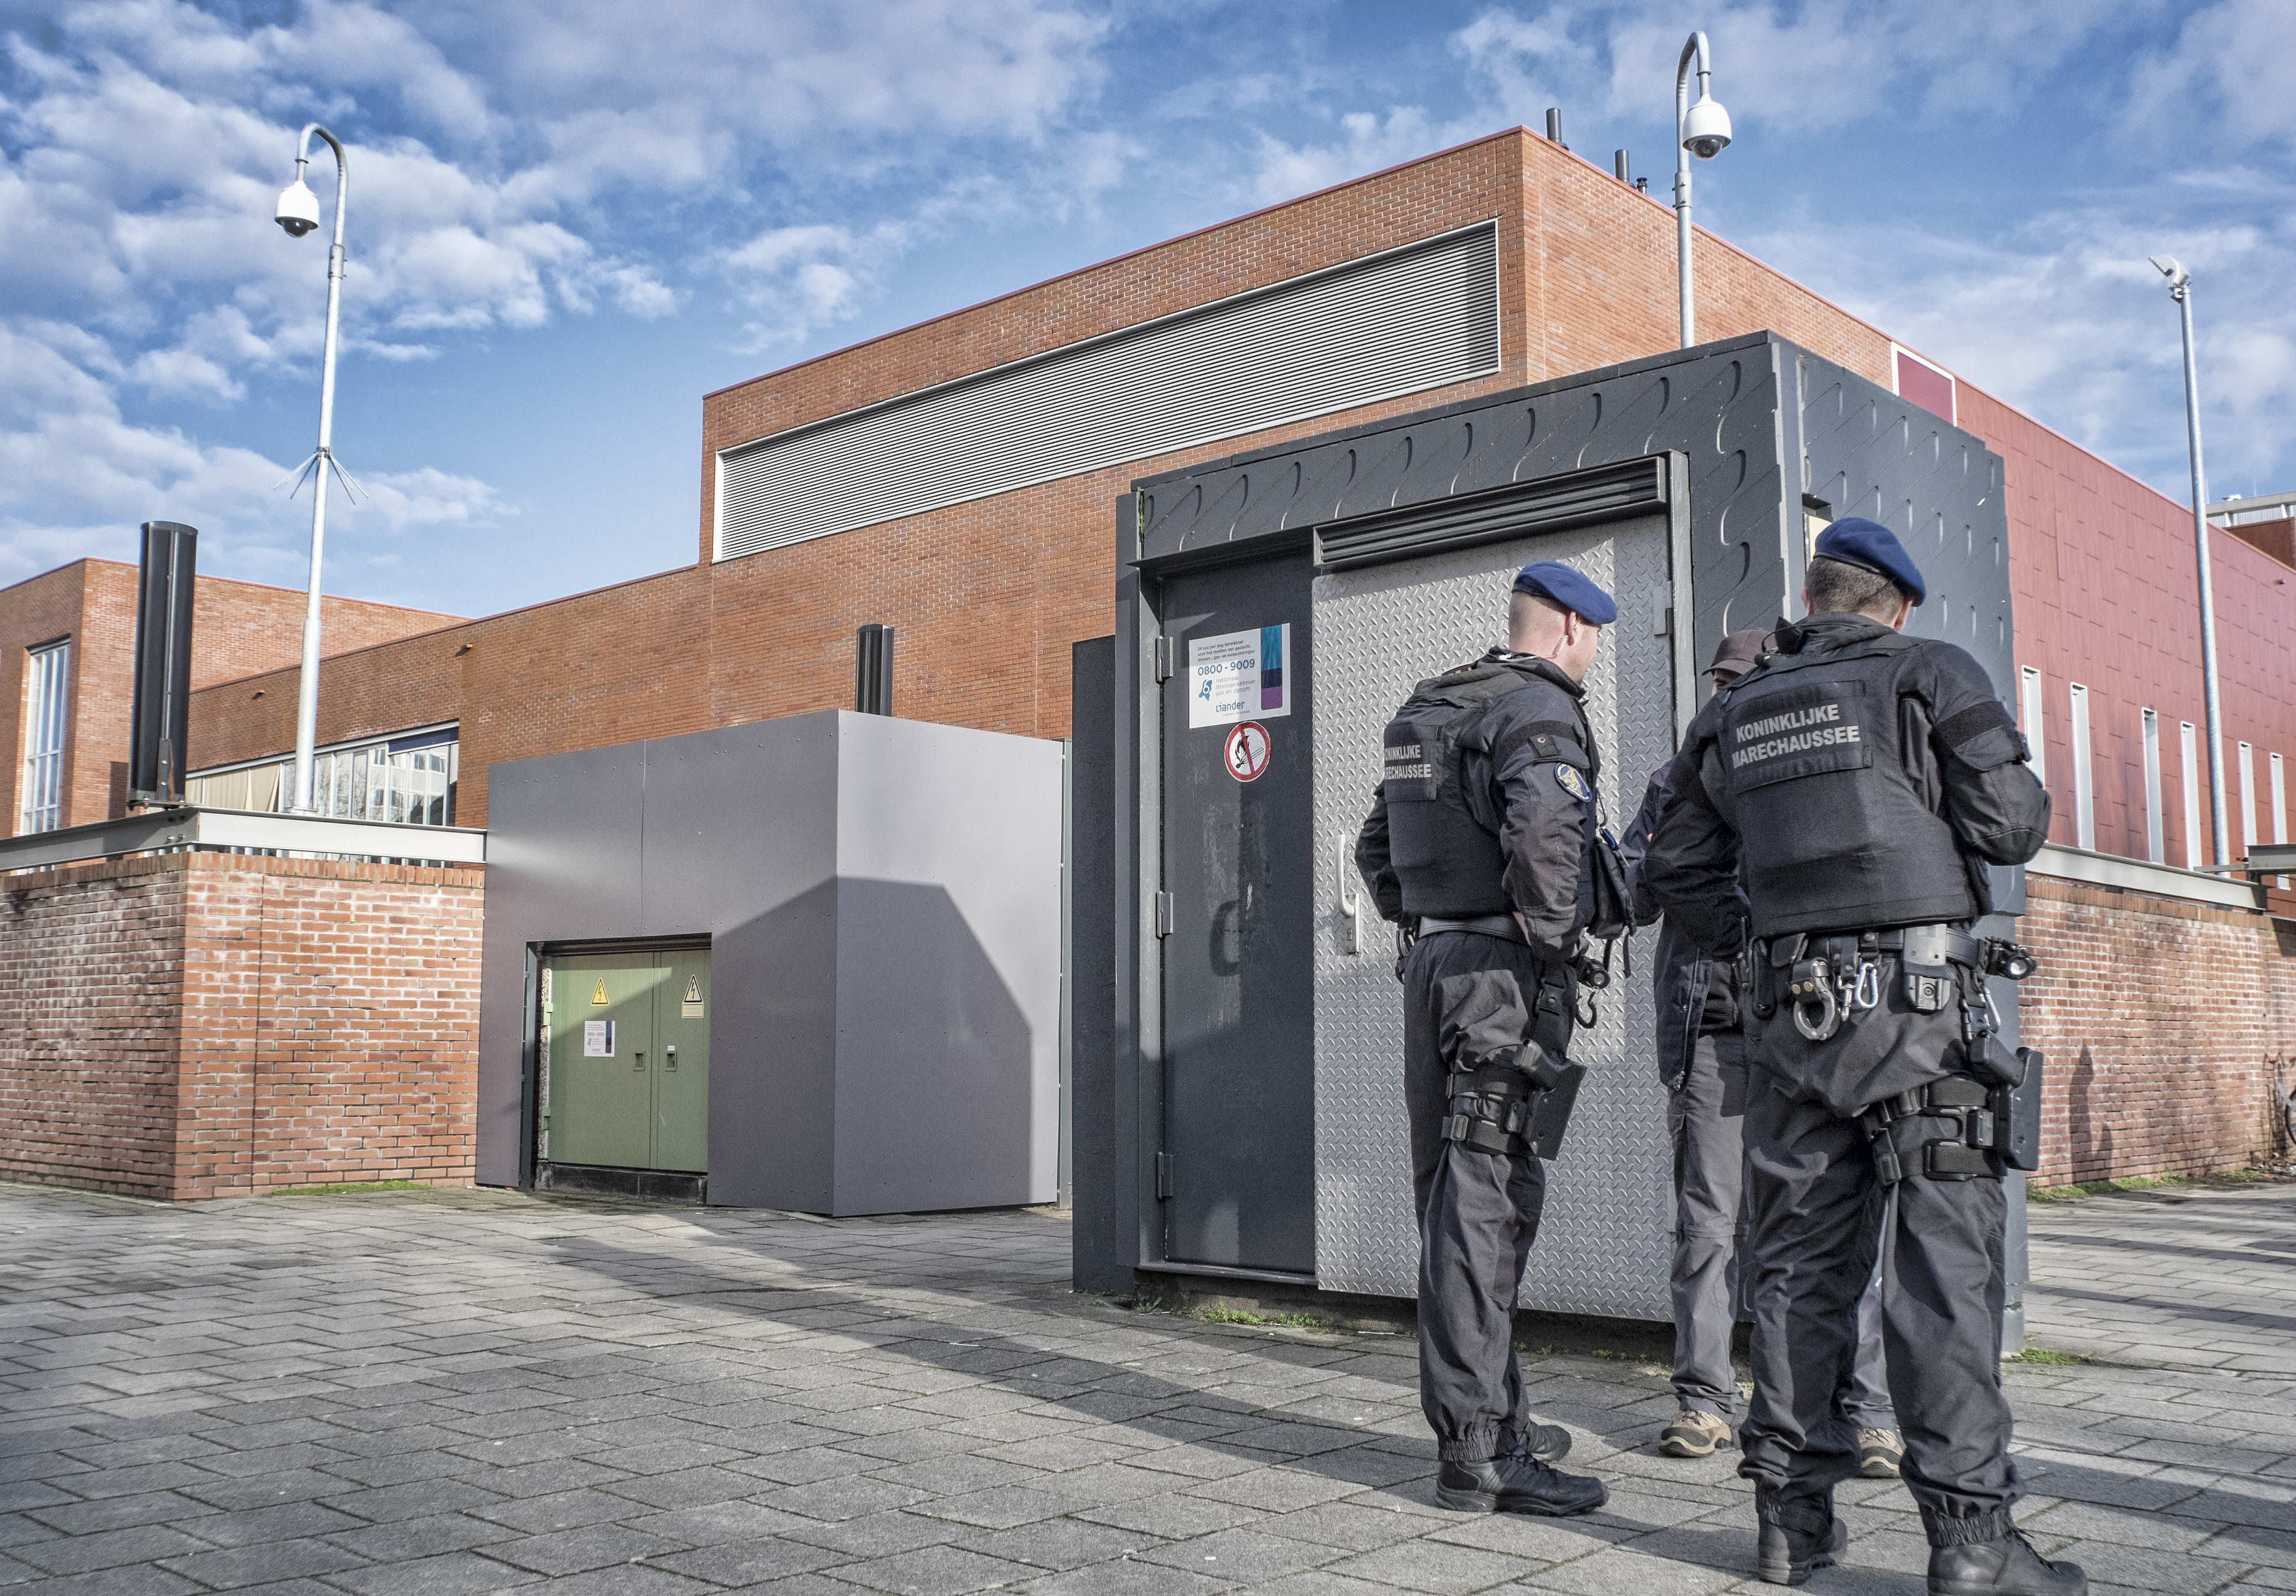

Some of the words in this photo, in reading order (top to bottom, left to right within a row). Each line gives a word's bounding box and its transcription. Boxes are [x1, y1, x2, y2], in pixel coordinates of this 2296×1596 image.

[1228, 649, 1256, 658] meterstoringen
[1198, 664, 1223, 676] 0800
[1230, 658, 1255, 671] 9009
[1216, 680, 1256, 689] storingsnummer
[1736, 704, 1840, 743] KONINKLIJKE
[1385, 744, 1421, 761] ONINKLIJKE
[1732, 725, 1861, 769] MARECHAUSSEE
